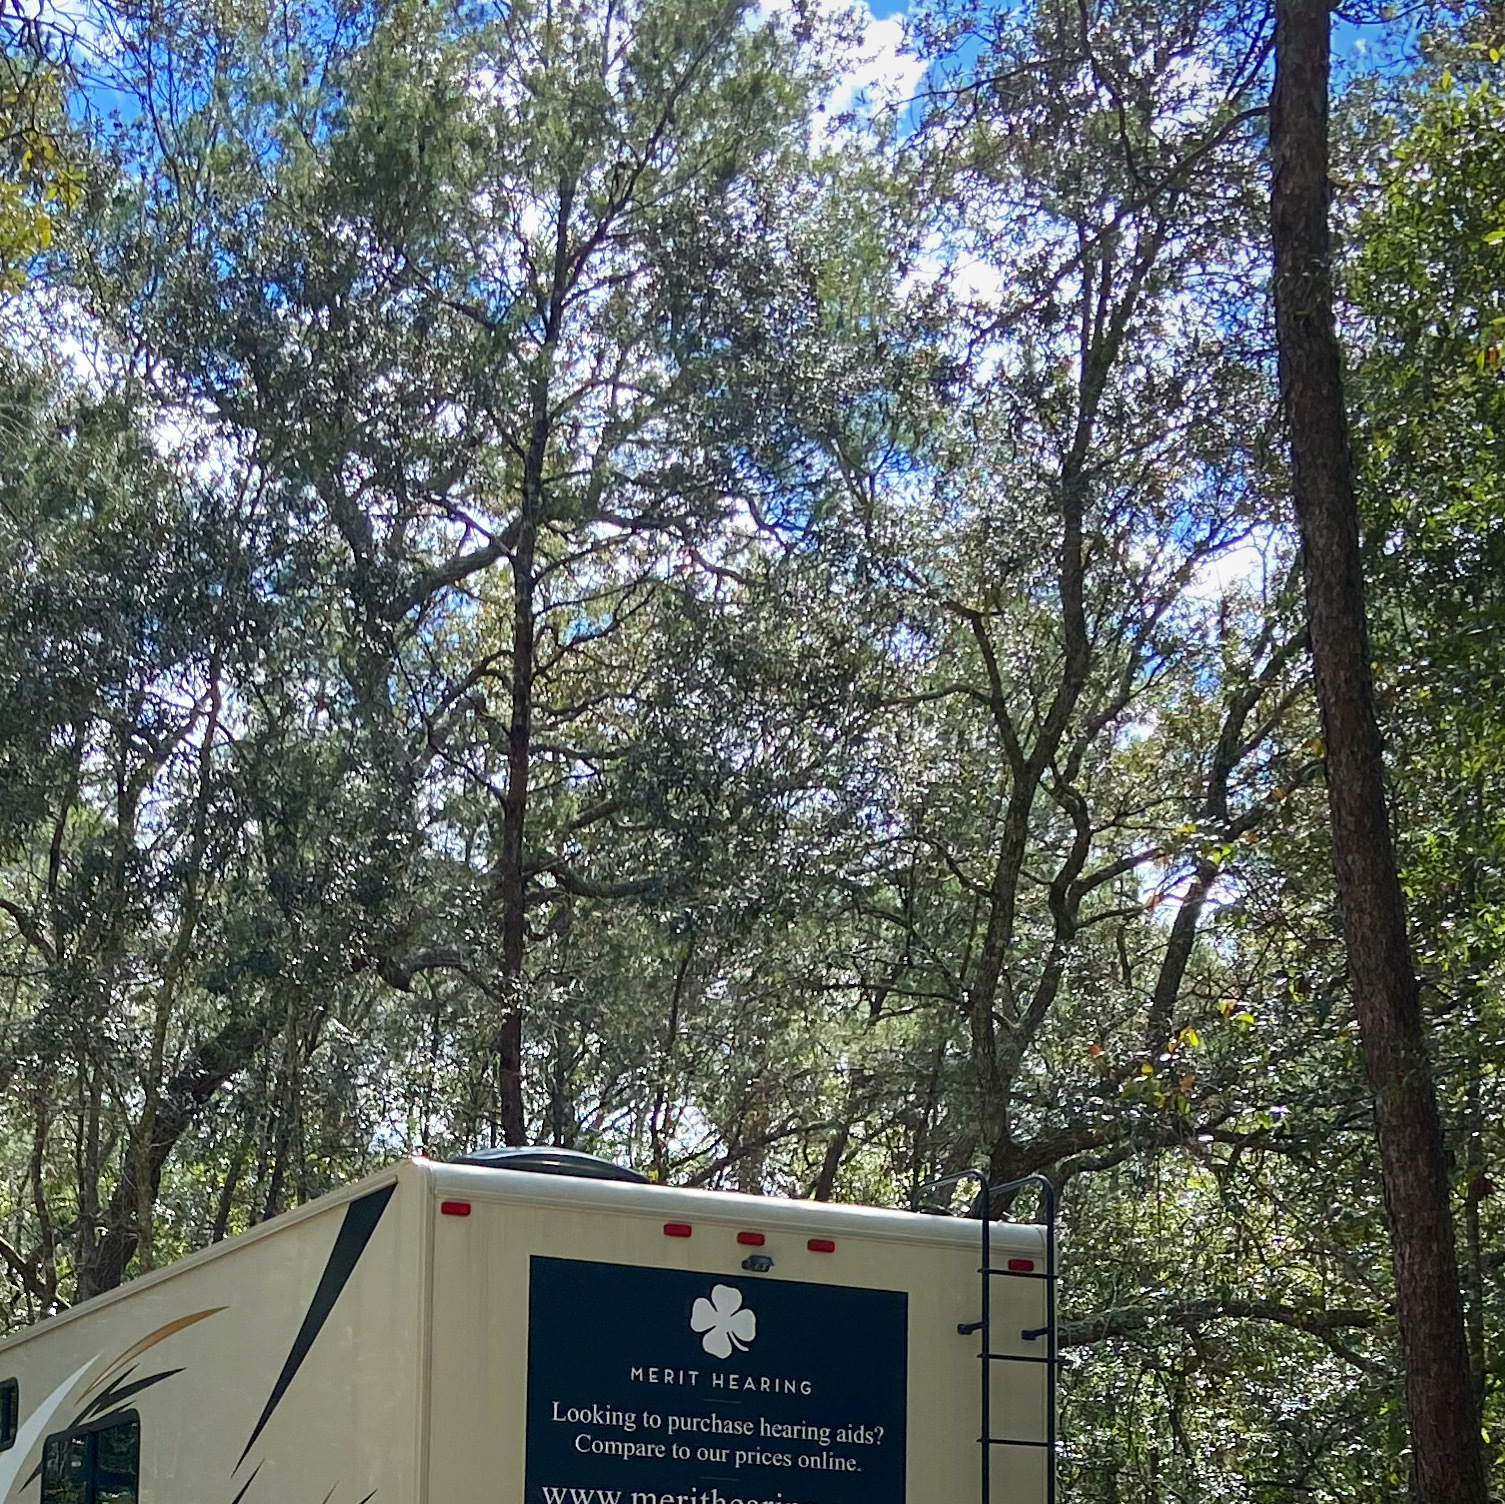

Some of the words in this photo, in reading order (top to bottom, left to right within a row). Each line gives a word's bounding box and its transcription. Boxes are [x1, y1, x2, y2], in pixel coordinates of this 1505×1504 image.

[630, 1366, 699, 1386] MERIT
[712, 1372, 812, 1395] HEARING
[552, 1401, 637, 1432] Looking
[642, 1411, 662, 1429] to
[667, 1412, 755, 1436] purchase
[759, 1417, 831, 1447] hearing
[836, 1423, 884, 1445] aids?
[574, 1433, 666, 1461] Compare
[672, 1443, 691, 1460] to
[696, 1447, 730, 1463] our
[735, 1446, 792, 1469] prices
[797, 1451, 862, 1472] online.
